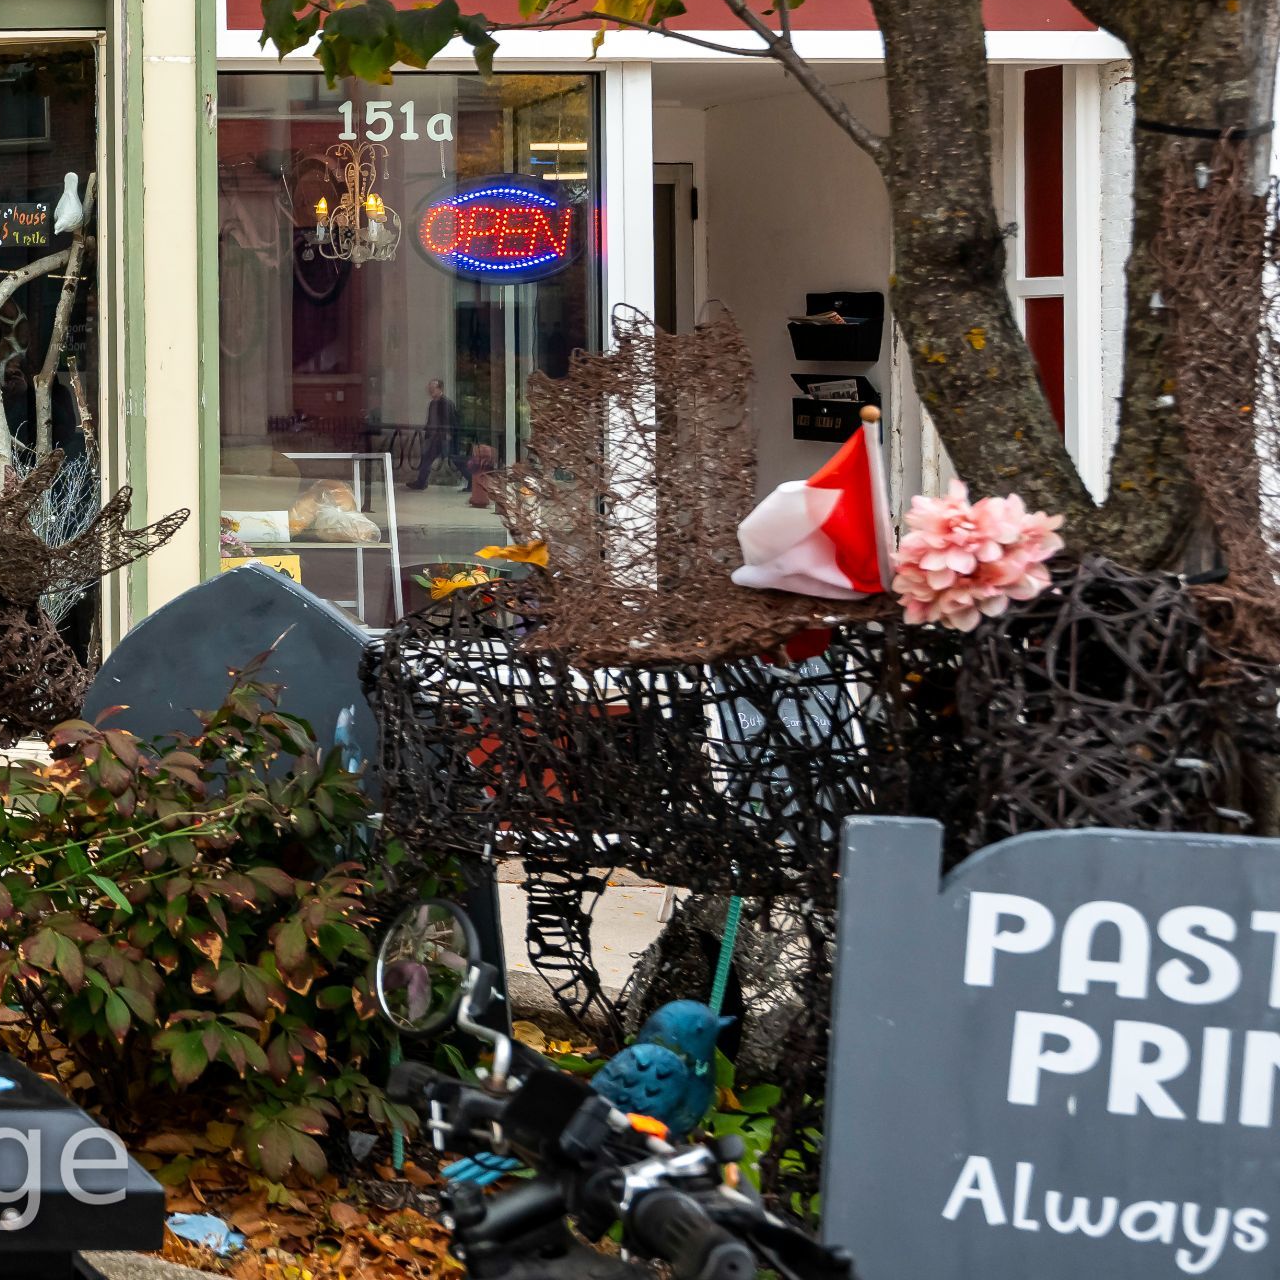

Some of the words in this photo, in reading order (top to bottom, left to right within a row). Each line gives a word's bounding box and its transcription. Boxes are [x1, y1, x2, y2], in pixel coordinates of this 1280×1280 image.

[337, 99, 454, 142] 151a
[13, 206, 47, 226] house
[425, 205, 571, 257] OPEN
[942, 1155, 1269, 1274] Always
